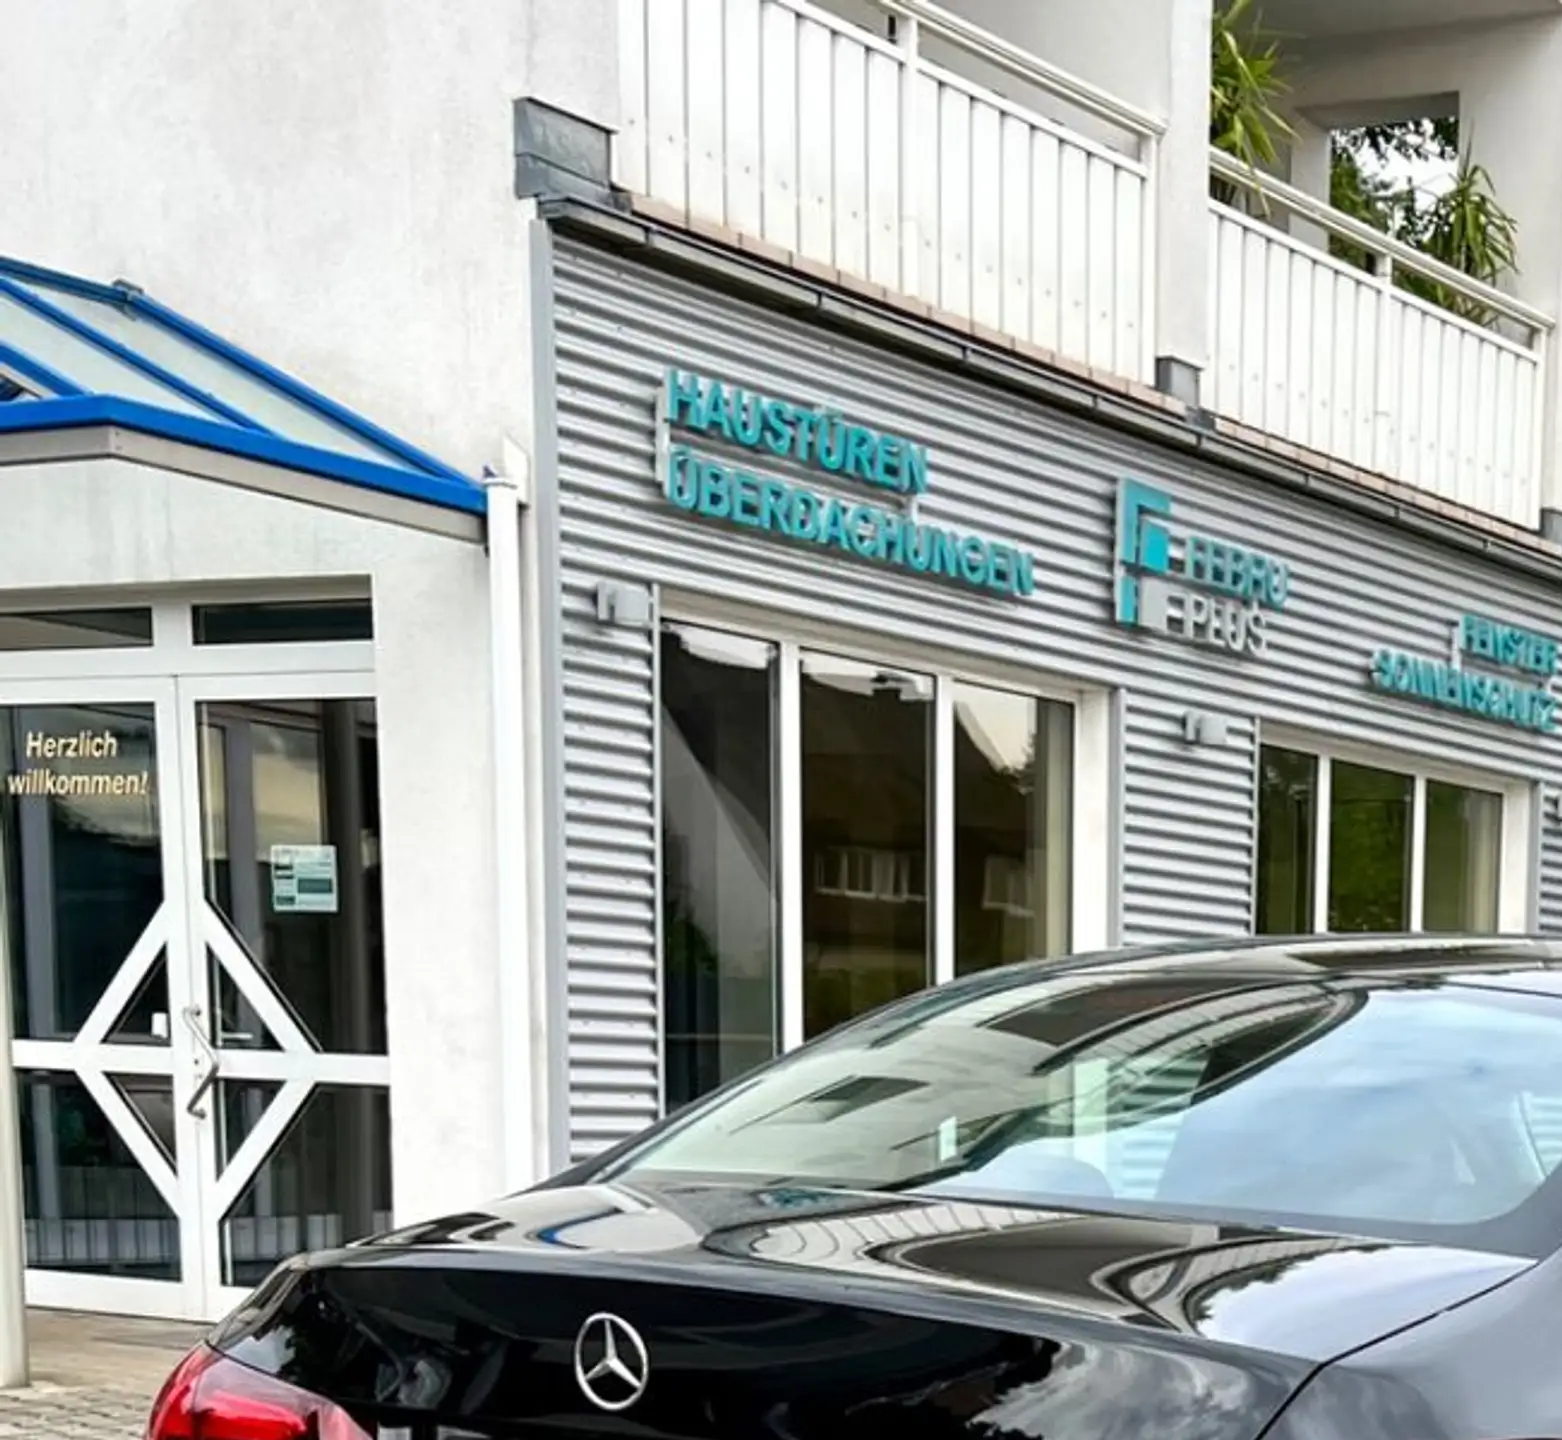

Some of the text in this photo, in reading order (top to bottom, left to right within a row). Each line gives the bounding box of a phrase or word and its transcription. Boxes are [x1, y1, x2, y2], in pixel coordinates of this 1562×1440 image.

[663, 367, 928, 494] HAUSTÜREN
[664, 443, 1036, 597] ÜBERDACHUNGEN
[7, 769, 149, 797] willkommen!
[26, 730, 118, 759] Herzlich
